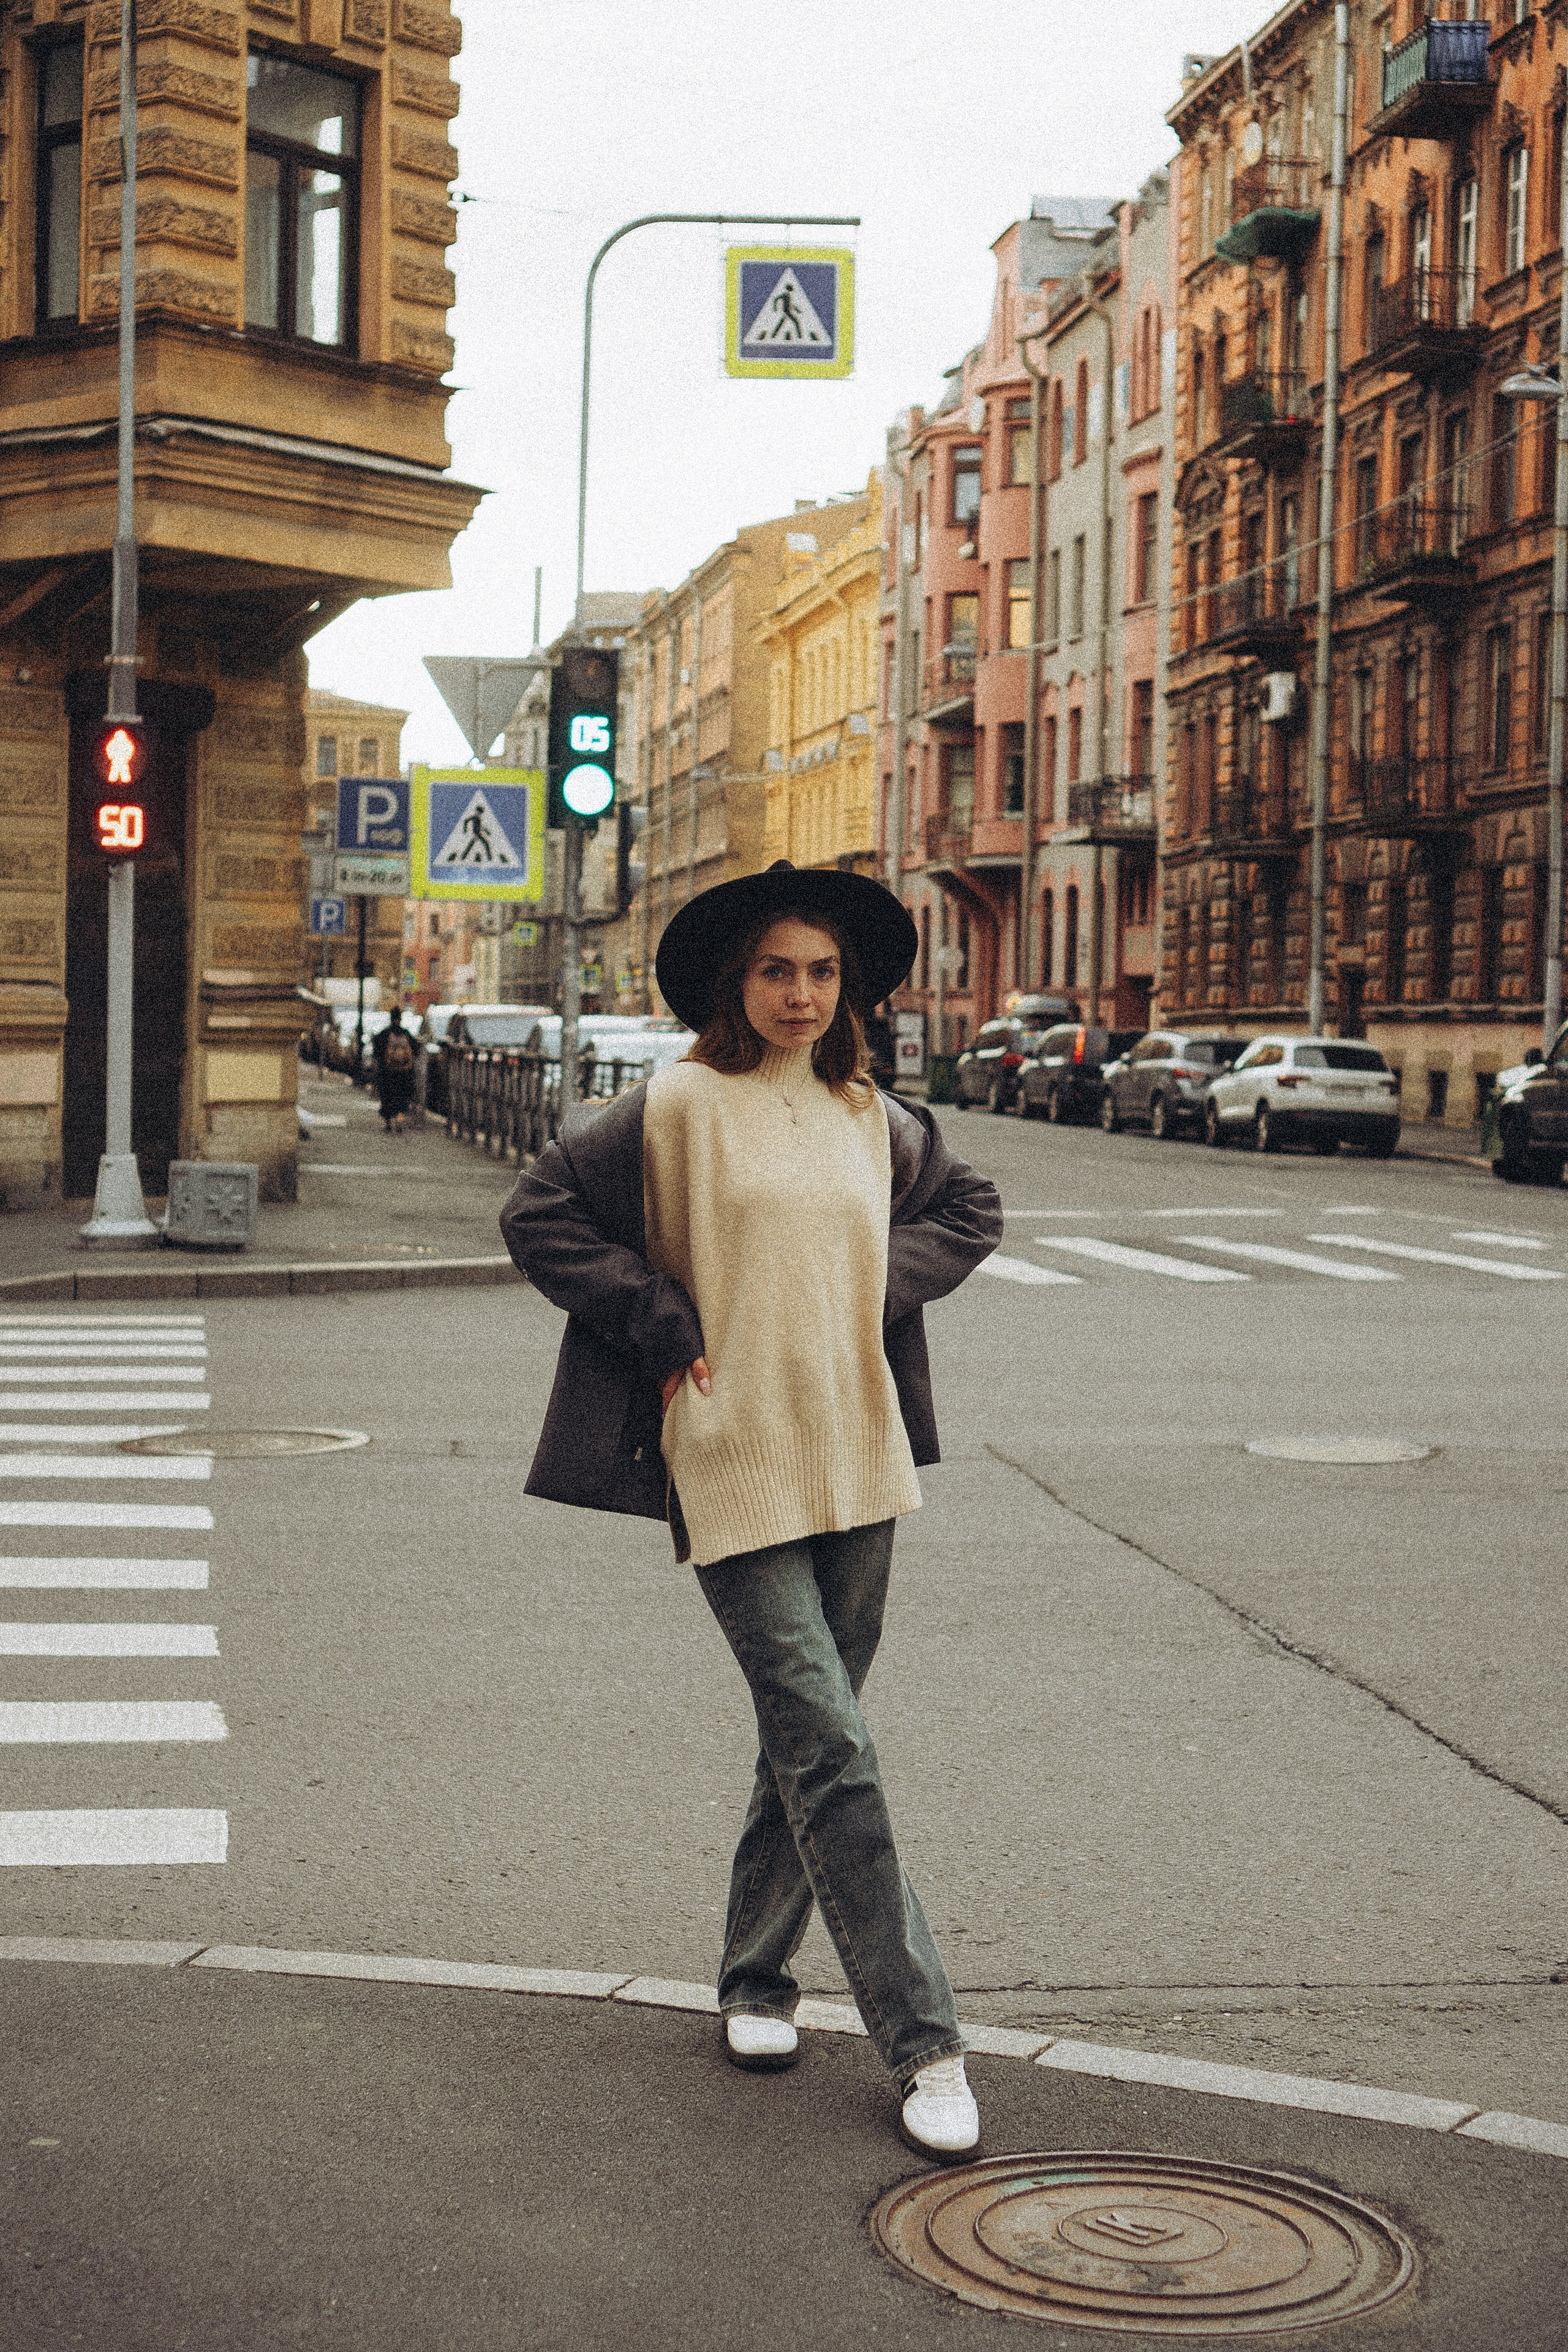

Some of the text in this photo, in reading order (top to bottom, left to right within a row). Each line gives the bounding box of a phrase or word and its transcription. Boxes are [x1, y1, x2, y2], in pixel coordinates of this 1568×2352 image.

[571, 715, 609, 752] 05
[99, 805, 143, 847] 50
[357, 786, 398, 844] P
[320, 902, 339, 930] P
